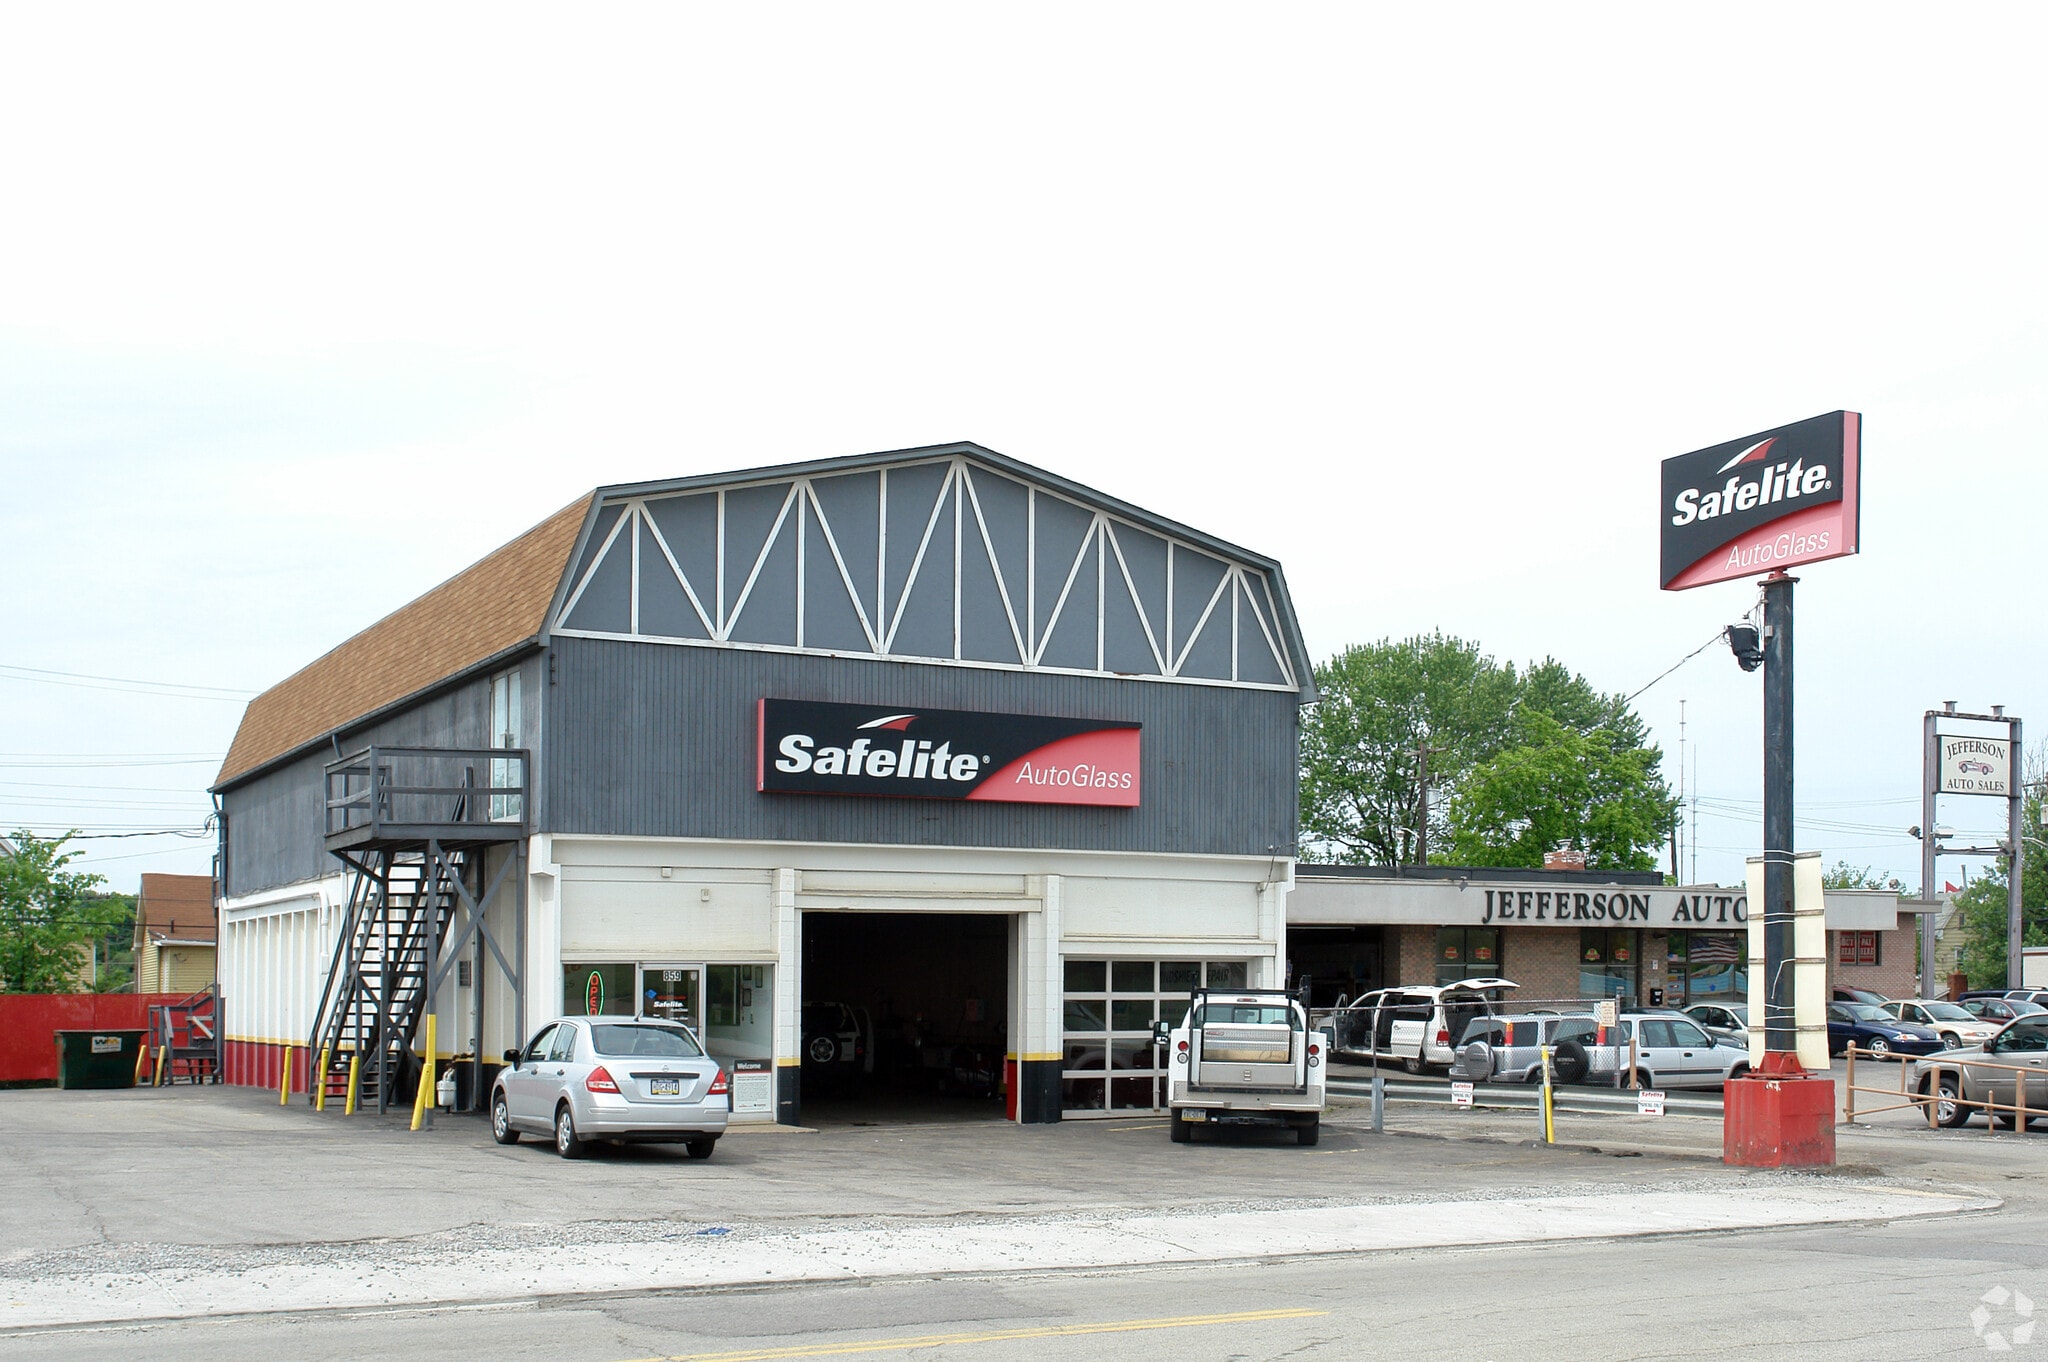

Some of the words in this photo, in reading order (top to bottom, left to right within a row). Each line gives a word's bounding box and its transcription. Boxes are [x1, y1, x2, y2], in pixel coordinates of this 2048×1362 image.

[1725, 531, 1831, 571] AutoGlass
[1946, 740, 2006, 761] JEFFERSON
[1015, 762, 1133, 789] AutoGlass
[1947, 778, 1974, 790] AUTO
[1978, 780, 2005, 792] SALES
[1482, 890, 1651, 924] JEFFERSON
[664, 971, 681, 981] 859
[1206, 968, 1230, 982] EPAIR
[736, 1062, 762, 1070] Welcome
